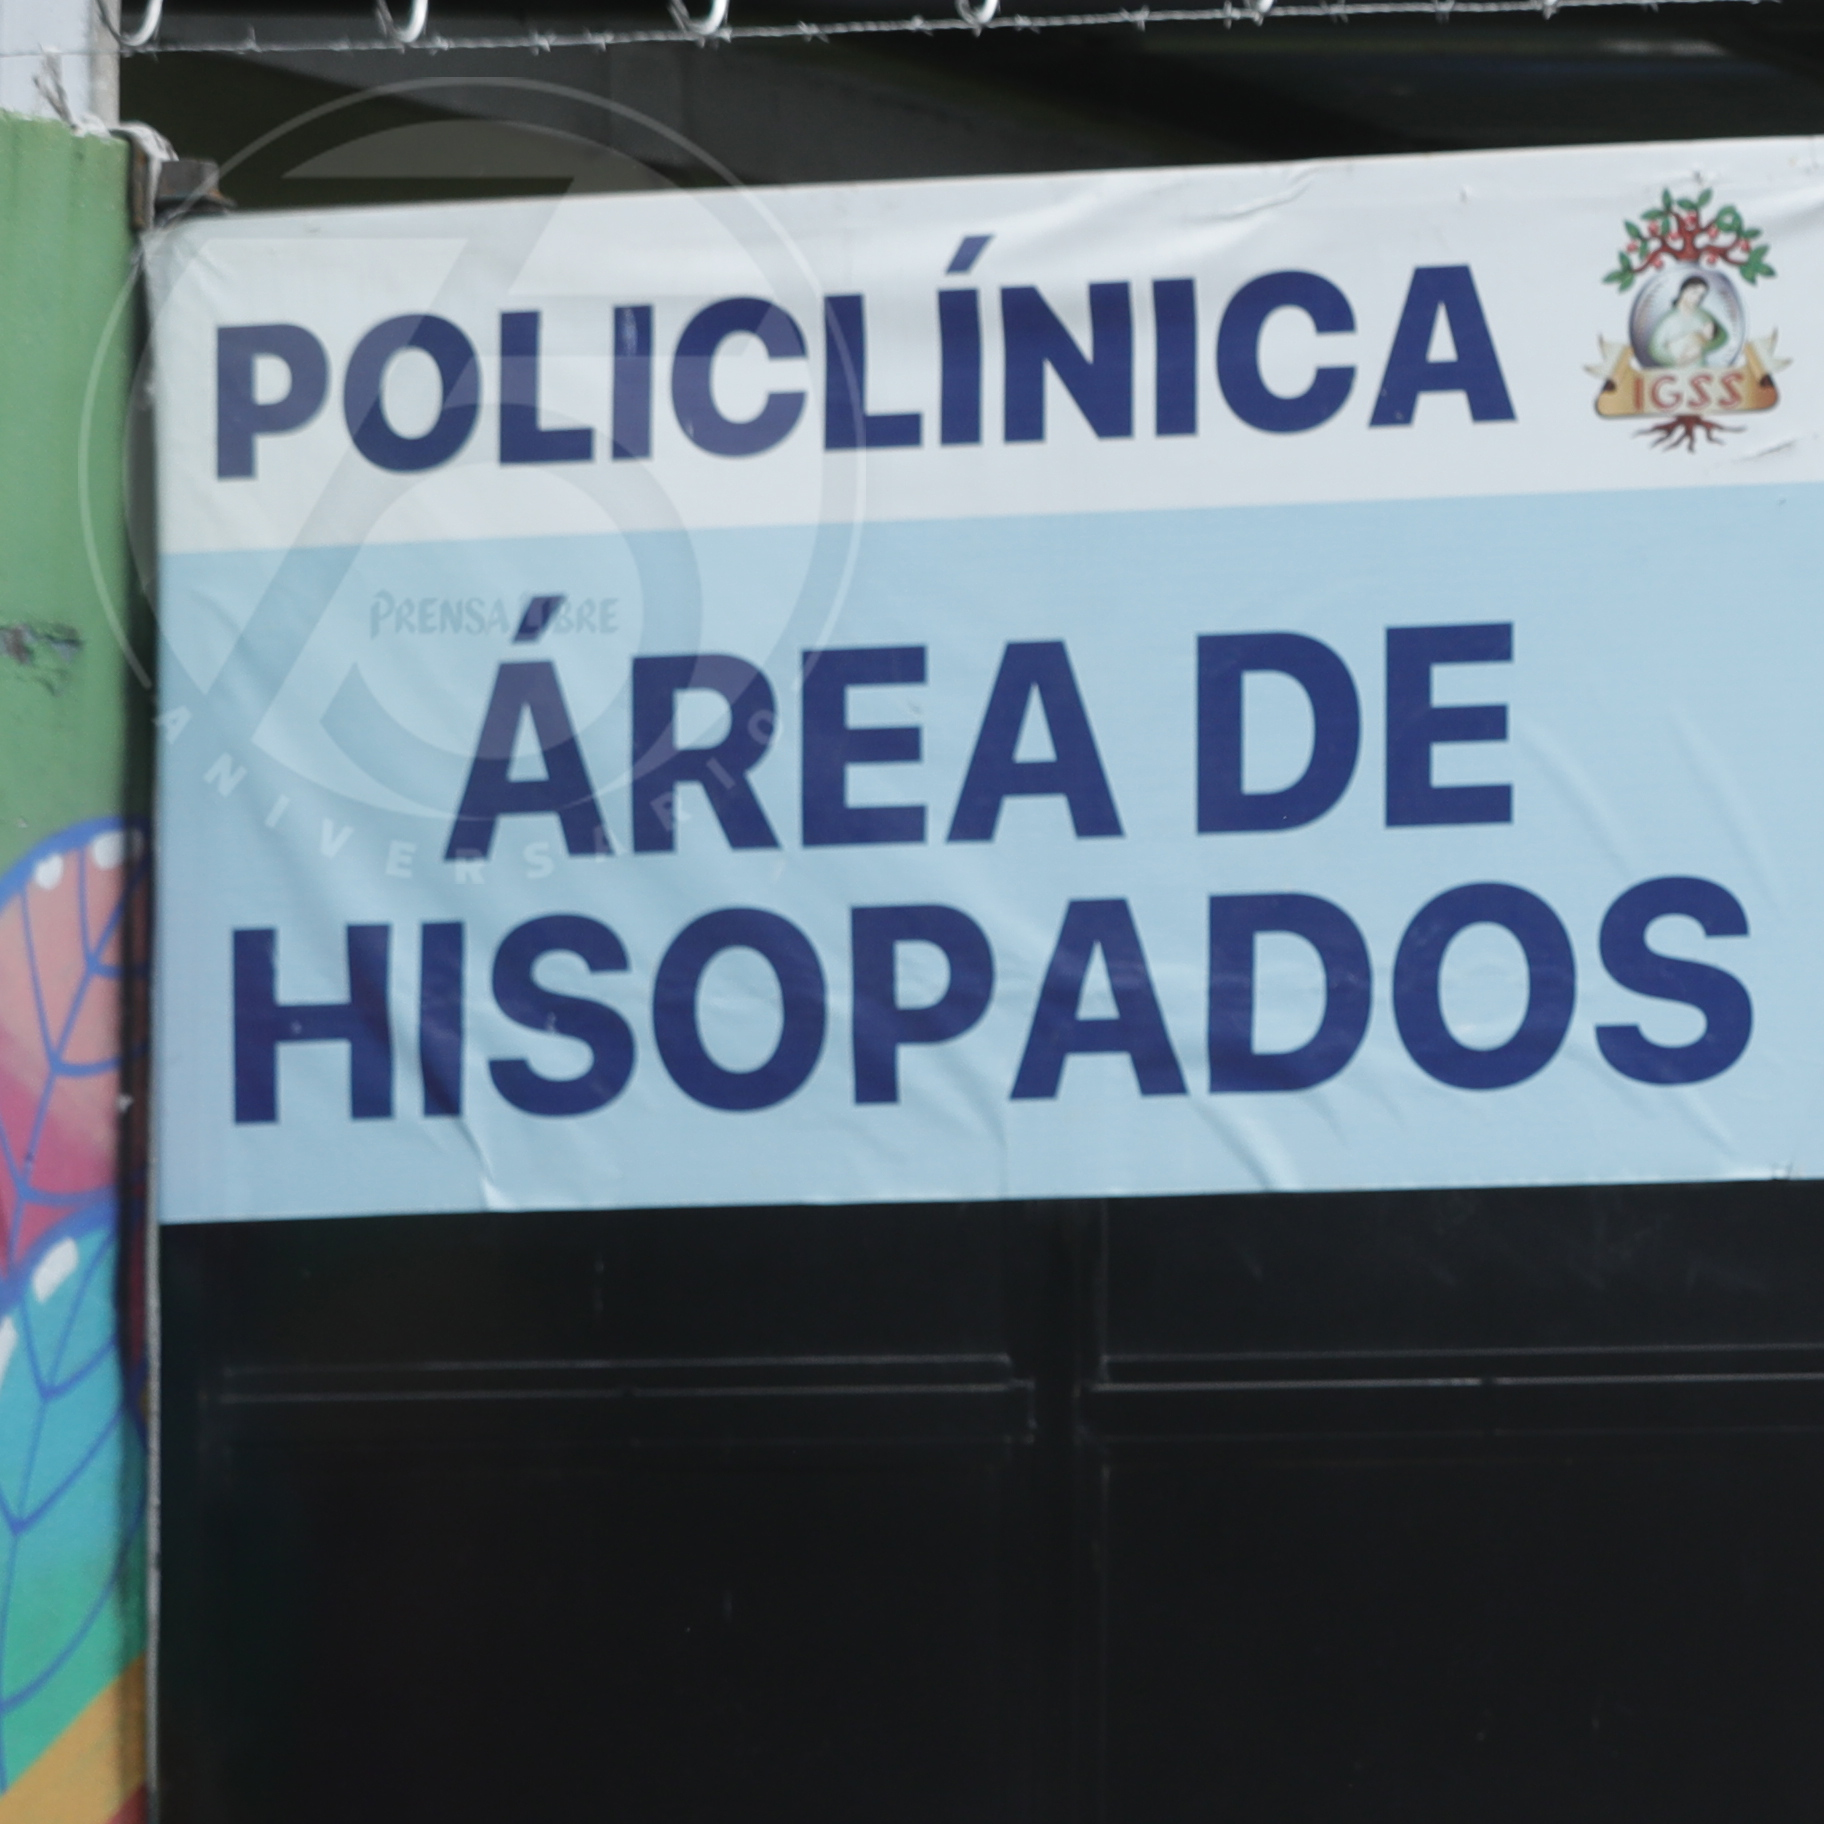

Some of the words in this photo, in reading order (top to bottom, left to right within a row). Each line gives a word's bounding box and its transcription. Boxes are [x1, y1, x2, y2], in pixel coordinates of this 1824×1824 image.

[212, 236, 1517, 480] POLICLÍNICA
[1632, 371, 1744, 413] IGSS
[444, 594, 1124, 862] ÁREA
[1195, 622, 1517, 836] DE
[230, 876, 1756, 1125] HISOPADOS
